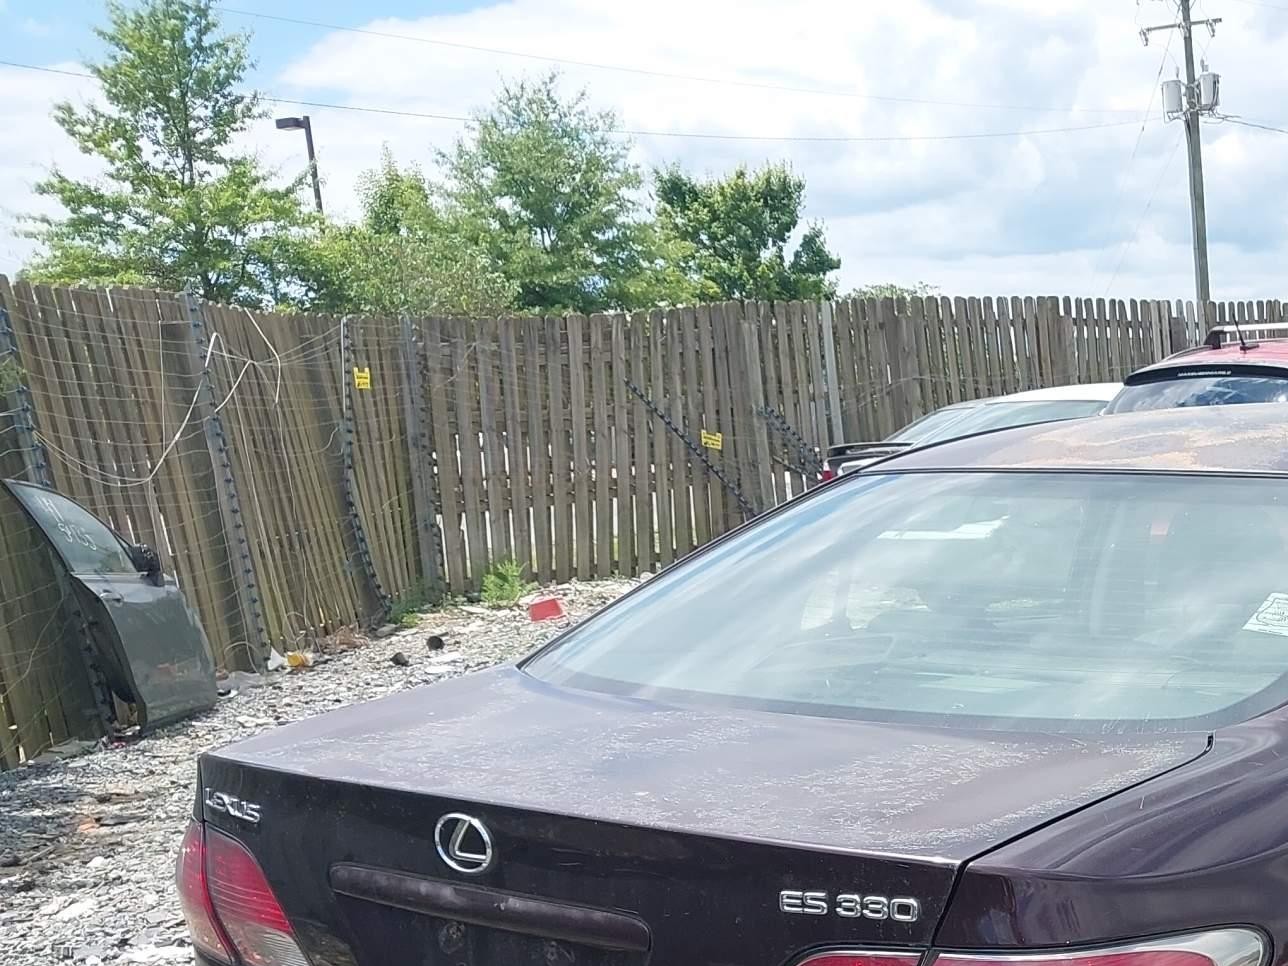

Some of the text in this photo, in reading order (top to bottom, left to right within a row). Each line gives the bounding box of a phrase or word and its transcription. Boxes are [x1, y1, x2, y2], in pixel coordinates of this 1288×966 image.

[204, 787, 261, 823] LEXUS
[779, 890, 920, 922] ES 330
